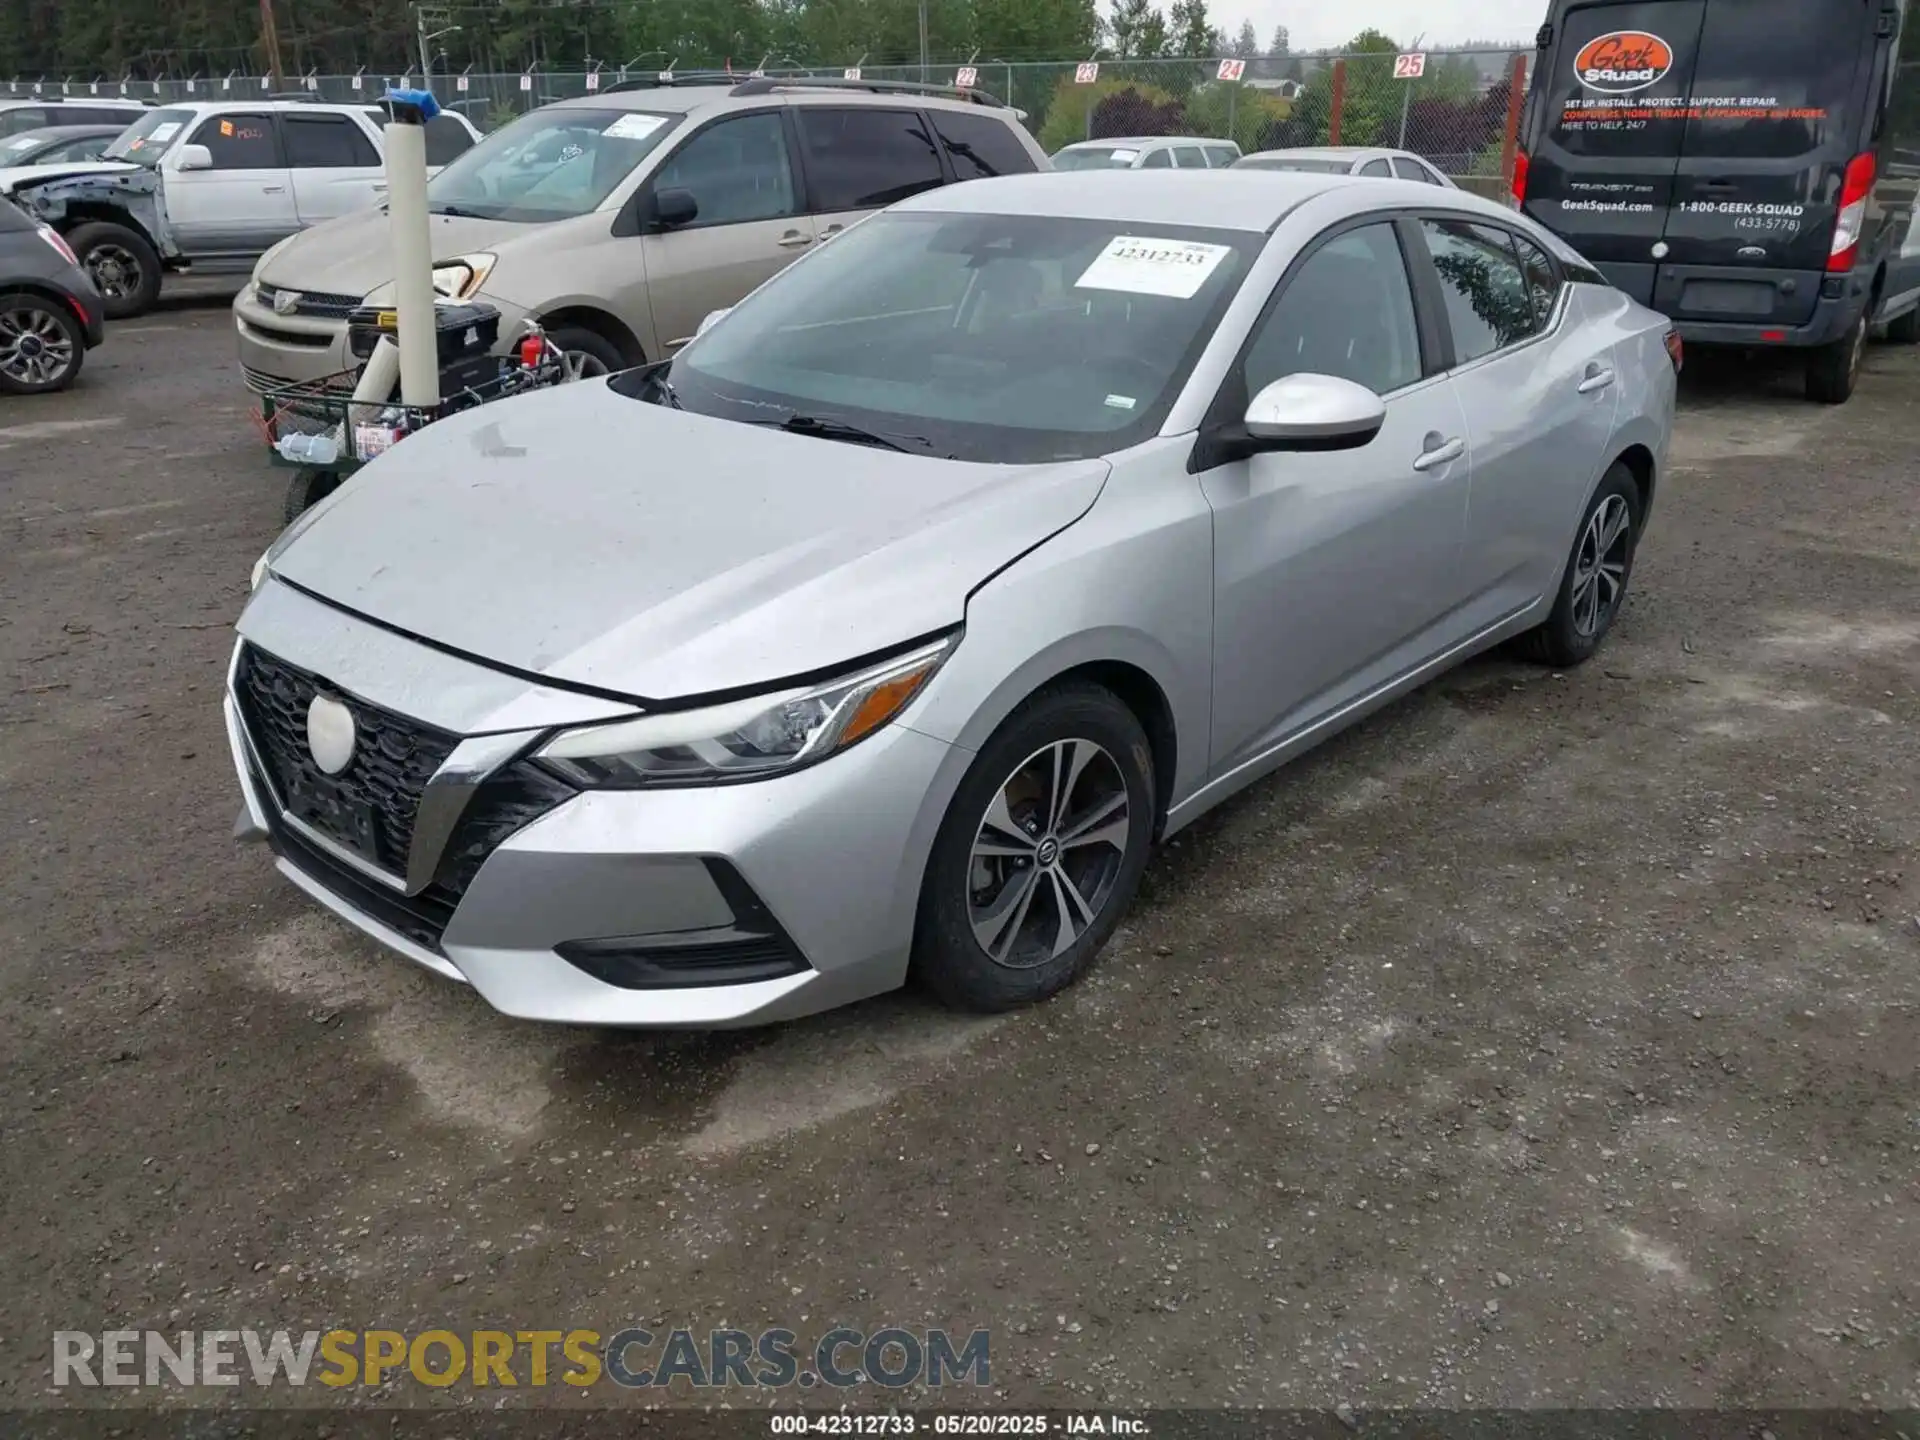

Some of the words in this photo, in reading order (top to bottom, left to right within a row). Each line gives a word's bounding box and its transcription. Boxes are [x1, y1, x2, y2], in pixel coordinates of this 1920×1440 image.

[1590, 37, 1653, 68] Geek
[1077, 64, 1096, 81] 23
[1220, 61, 1241, 80] 24
[1396, 55, 1422, 76] 25
[960, 69, 975, 85] 22
[1564, 99, 1581, 108] SET
[1689, 97, 1737, 106] SUPPORT.
[1561, 121, 1583, 130] HERE
[1585, 121, 1598, 130] TO
[1626, 120, 1647, 129] 24/7
[1562, 200, 1653, 213] GeekSquad.com
[1680, 201, 1804, 216] 1-800-GEEK-SQUAD
[1734, 217, 1801, 232] (433-5778)
